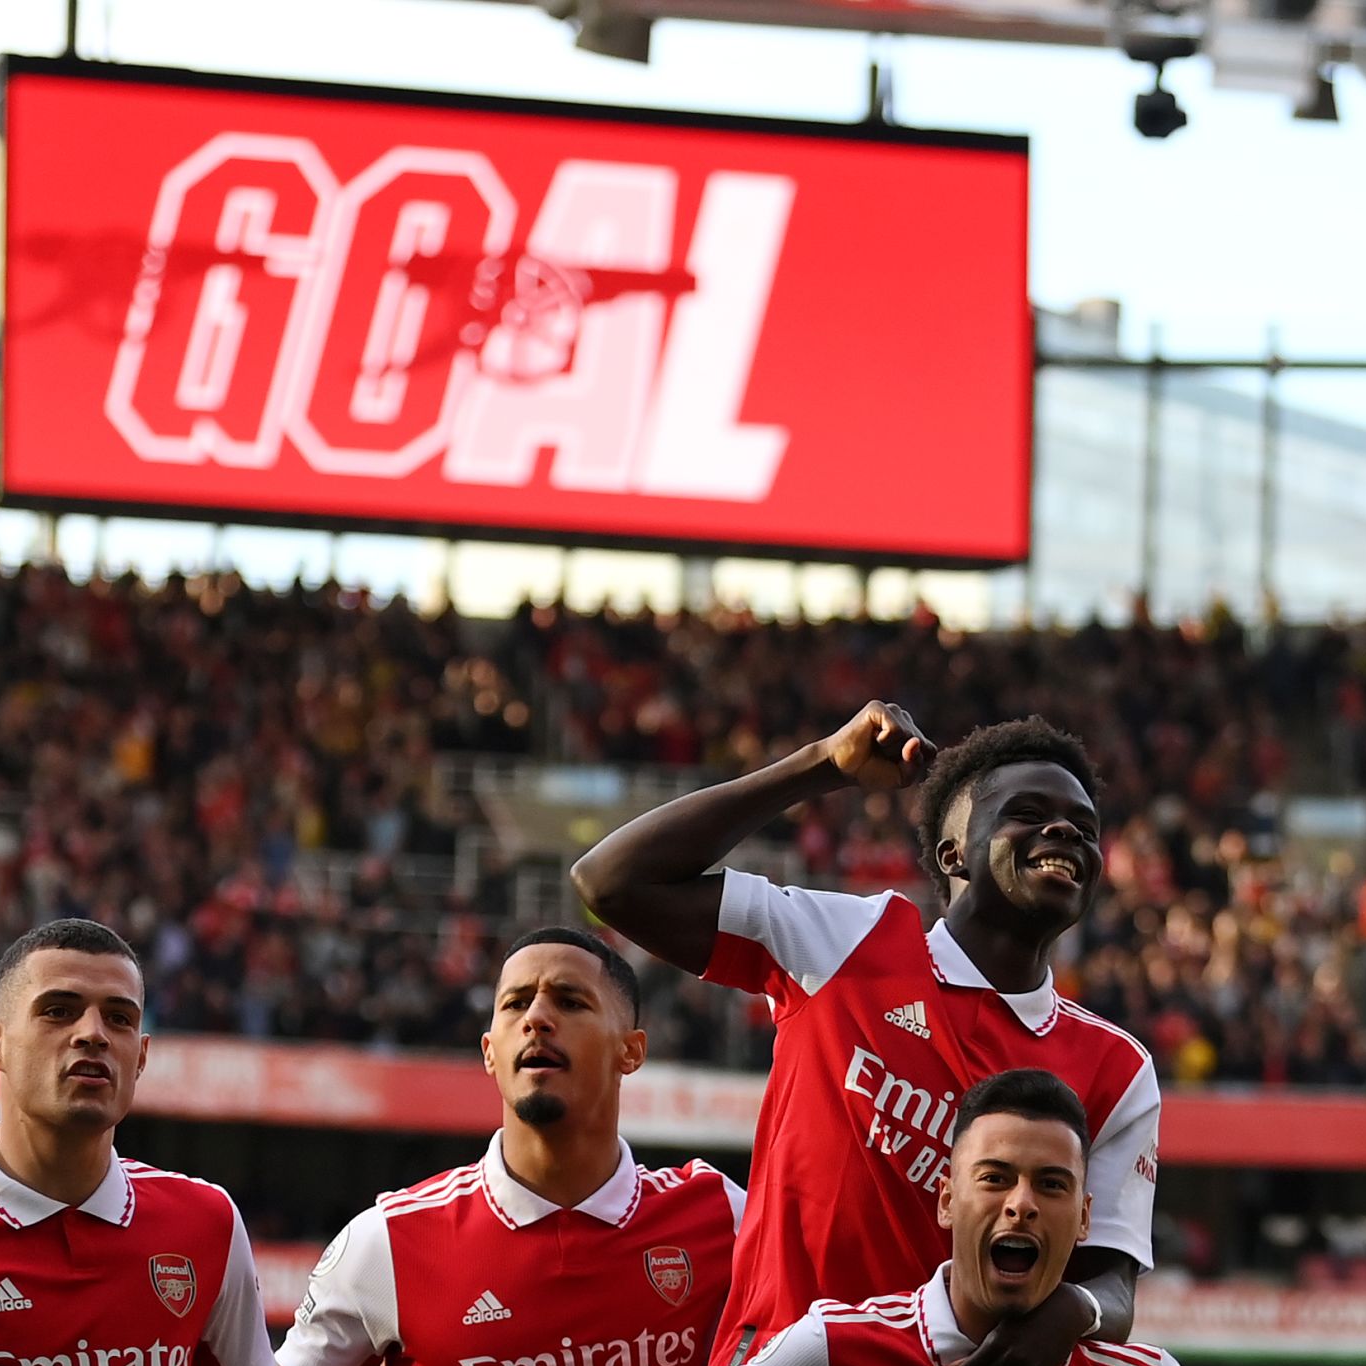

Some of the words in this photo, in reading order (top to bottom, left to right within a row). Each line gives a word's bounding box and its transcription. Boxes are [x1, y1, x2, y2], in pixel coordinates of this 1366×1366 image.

[105, 131, 797, 502] GOAL
[884, 1011, 931, 1040] adidas
[156, 1264, 188, 1275] Arsenal
[651, 1255, 685, 1266] Arsenal
[462, 1306, 512, 1326] adidas
